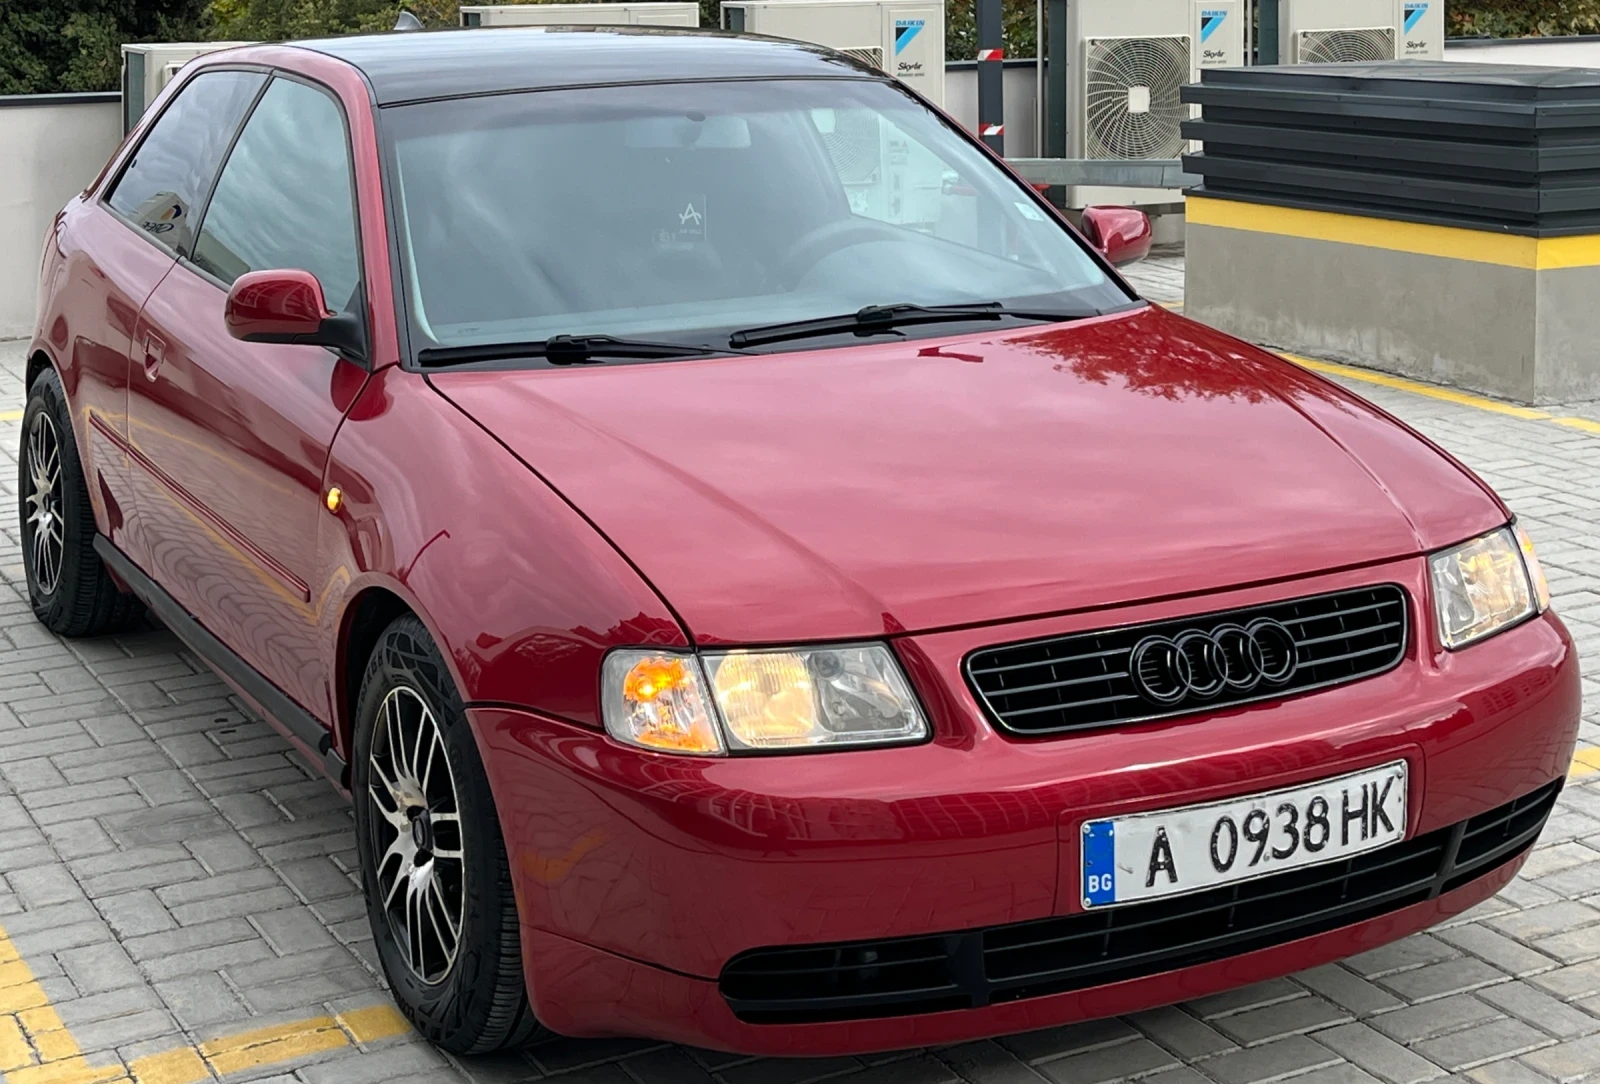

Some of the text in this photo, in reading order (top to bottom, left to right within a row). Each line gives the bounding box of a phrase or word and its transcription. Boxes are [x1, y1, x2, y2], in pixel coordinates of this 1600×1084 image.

[1145, 775, 1395, 888] A 0938 HK
[1087, 873, 1113, 893] BG
